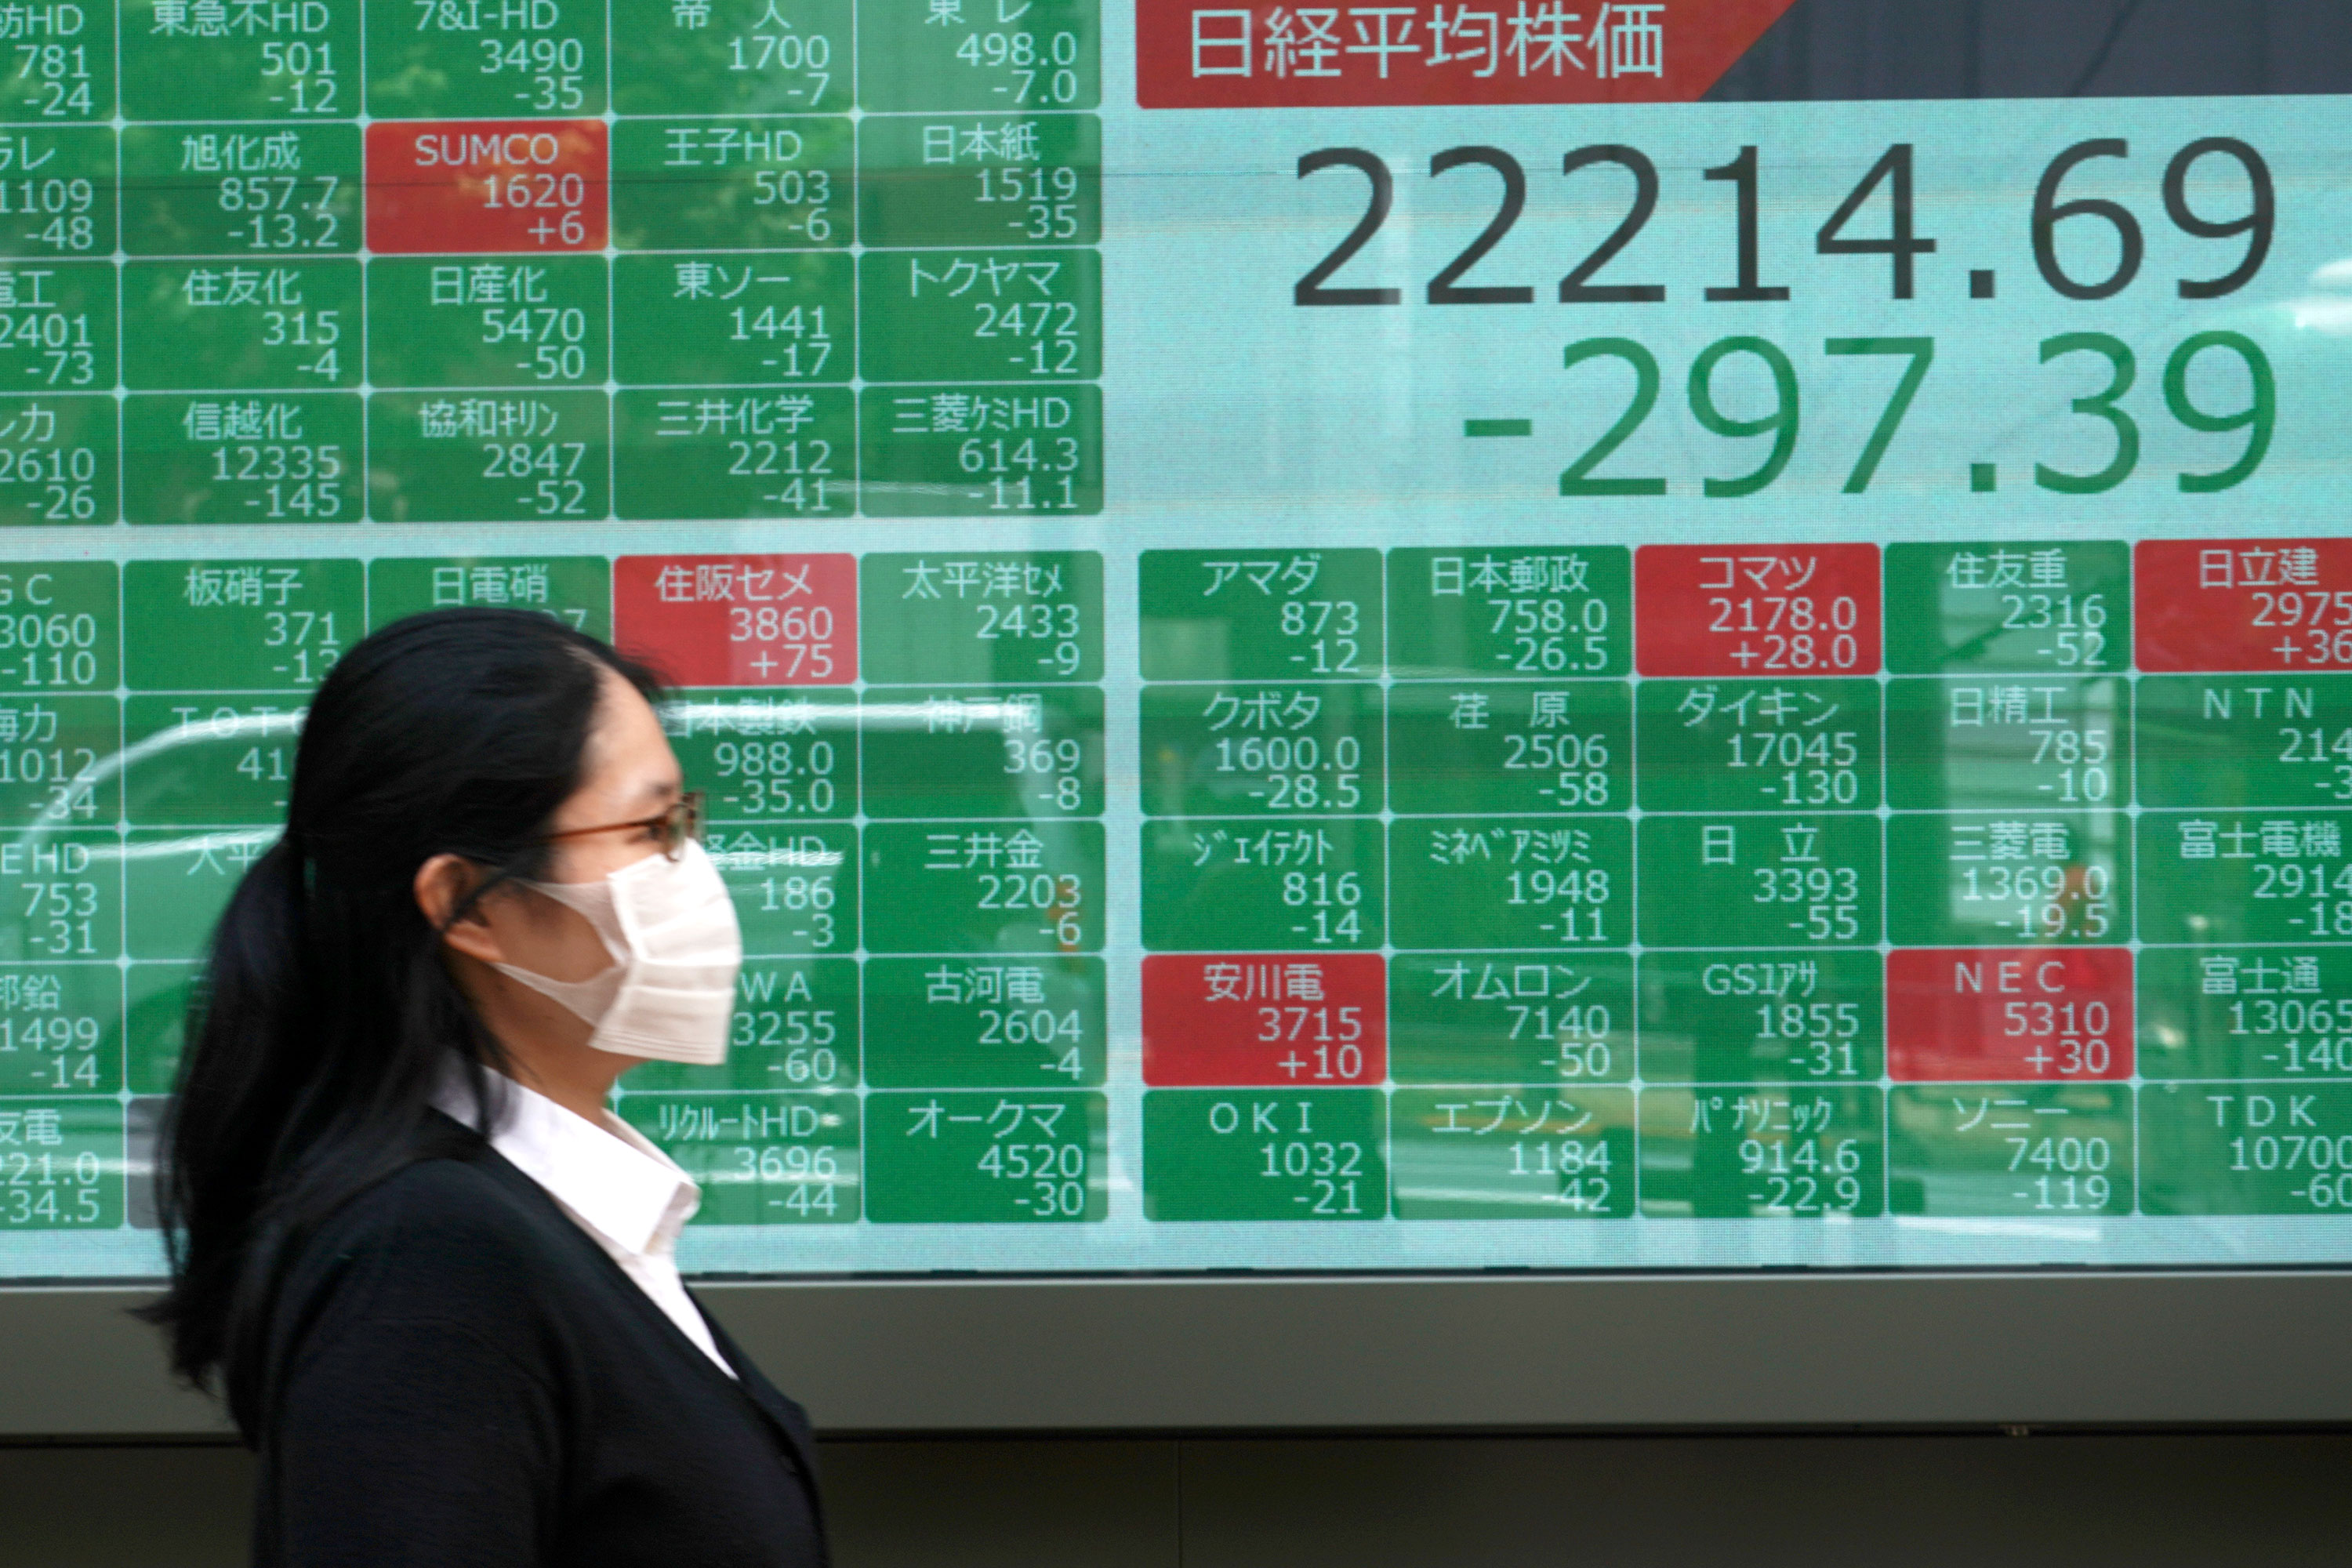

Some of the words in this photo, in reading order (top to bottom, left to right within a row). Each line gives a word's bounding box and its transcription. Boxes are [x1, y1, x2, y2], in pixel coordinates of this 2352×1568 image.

[150, 0, 329, 37] 東急不HD
[413, 0, 559, 31] 7&I-HD
[481, 38, 582, 72] 3490
[729, 36, 828, 69] 1700
[956, 32, 1075, 65] 498.0
[1190, 2, 1664, 80] 日経平均株価
[15, 45, 89, 78] 781
[262, 42, 334, 75] 501
[24, 82, 91, 114] -24
[270, 80, 337, 113] -12
[514, 77, 583, 110] -35
[788, 73, 830, 105] -7
[993, 70, 1076, 103] -7.0
[182, 132, 299, 169] 旭化成
[415, 134, 557, 166] SUMCO
[664, 129, 800, 164] 王子HD
[924, 122, 1039, 161] 日本紙
[219, 176, 337, 210] 857.7
[484, 173, 584, 209] 1620
[753, 170, 829, 205] 503
[976, 167, 1076, 201] 1519
[25, 216, 92, 249] -48
[228, 214, 338, 248] -13.2
[528, 211, 584, 244] +6
[789, 209, 831, 241] -6
[1009, 205, 1076, 238] -35
[1293, 136, 2274, 307] 22214.69
[182, 269, 302, 305] 住友化
[431, 264, 546, 301] 日産化
[673, 262, 789, 299] 東ソー
[912, 259, 1058, 296] トクヤマ
[263, 310, 337, 344] 315
[483, 308, 583, 341] 5470
[731, 307, 828, 339] 1441
[975, 303, 1076, 336] 2472
[26, 350, 93, 383] -73
[297, 349, 339, 380] -4
[517, 345, 583, 379] -50
[763, 343, 830, 376] -17
[1010, 340, 1076, 373] -12
[183, 401, 301, 437] 信越化
[658, 395, 812, 432] 三井化学
[1463, 329, 2277, 498] -297.39
[212, 445, 340, 479] 12335
[483, 443, 584, 474] 2847
[729, 440, 830, 472] 2212
[959, 437, 1076, 470] 614.3
[27, 485, 95, 518] -26
[245, 484, 340, 517] -145
[517, 481, 585, 514] -52
[764, 477, 828, 510] -41
[968, 477, 1077, 509] -11.1
[655, 565, 811, 600] 住阪セメ
[1203, 557, 1316, 594] アマダ
[1433, 555, 1588, 592] 日本郵政
[1700, 557, 1816, 590] コマツ
[1947, 550, 2067, 587] 住友重
[2201, 548, 2318, 586] 日立建
[184, 568, 303, 607] 板硝子
[433, 564, 549, 606] 日電硝
[731, 607, 832, 640] 3860
[977, 604, 1077, 637] 2433
[1281, 601, 1357, 634] 873
[1488, 599, 1606, 632] 758.0
[1710, 597, 1856, 630] 2178.0
[2002, 594, 2107, 628] 2316
[265, 612, 338, 645] 371
[751, 644, 832, 677] +75
[1037, 642, 1078, 675] -9
[1288, 640, 1359, 673] -12
[1497, 637, 1606, 670] -26.5
[1731, 634, 1856, 668] +28.0
[2038, 633, 2107, 666] -52
[2, 651, 96, 686] -110
[1203, 691, 1319, 728] クボタ
[1678, 688, 1837, 724] ダイキン
[1951, 685, 2069, 724] 日精工
[714, 742, 833, 776] 988.0
[1004, 739, 1079, 771] 369
[1216, 737, 1359, 769] 1600.0
[1504, 735, 1607, 767] 2506
[1728, 732, 1856, 765] 17045
[2030, 728, 2107, 762] 785
[724, 779, 833, 812] -35.0
[1038, 777, 1080, 809] -8
[1249, 774, 1359, 808] -28.5
[1539, 771, 1607, 805] -58
[1761, 770, 1856, 804] -130
[2038, 768, 2107, 801] -10
[29, 786, 98, 820] -34
[924, 829, 1044, 869] 三井金
[1951, 822, 2070, 859] 三菱電
[2179, 820, 2339, 857] 富士電機
[760, 876, 834, 909] 186
[978, 874, 1080, 907] 2203
[1283, 872, 1359, 904] 816
[1508, 870, 1608, 902] 1948
[1754, 868, 1857, 901] 3393
[1962, 863, 2108, 898] 1369.0
[22, 883, 96, 916] 753
[31, 920, 94, 953] -31
[793, 913, 834, 947] -3
[1040, 912, 1082, 945] -6
[1292, 909, 1360, 942] -14
[1540, 908, 1606, 941] -11
[1788, 905, 1857, 939] -55
[1996, 904, 2109, 937] -19.5
[925, 965, 1043, 1002] 古河電
[1205, 963, 1323, 999] 安川電
[1432, 961, 1589, 997] オムロン
[2199, 956, 2320, 993] 富士通
[735, 1011, 834, 1044] 3255
[978, 1011, 1080, 1043] 2604
[1259, 1007, 1360, 1040] 3715
[1506, 1005, 1609, 1038] 7140
[1756, 1004, 1859, 1038] 1855
[2005, 1002, 2108, 1035] 5310
[32, 1055, 98, 1087] -14
[768, 1048, 836, 1082] -60
[1040, 1047, 1081, 1079] -4
[1279, 1045, 1361, 1078] +10
[1540, 1044, 1610, 1077] -50
[1788, 1041, 1857, 1076] -31
[2025, 1040, 2109, 1073] +30
[907, 1100, 1064, 1135] オークマ
[1432, 1095, 1592, 1134] エプソン
[1954, 1097, 2067, 1131] ソニー
[734, 1145, 836, 1179] 3696
[978, 1145, 1082, 1174] 4520
[1261, 1142, 1361, 1174] 1032
[1510, 1142, 1610, 1173] 1184
[1738, 1139, 1860, 1172] 914.6
[2006, 1138, 2109, 1171] 7400
[768, 1182, 836, 1216] -44
[1014, 1179, 1083, 1214] -30
[1294, 1180, 1359, 1212] -21
[1542, 1178, 1610, 1211] -42
[1748, 1176, 1860, 1210] -22.9
[2013, 1175, 2109, 1210] -119
